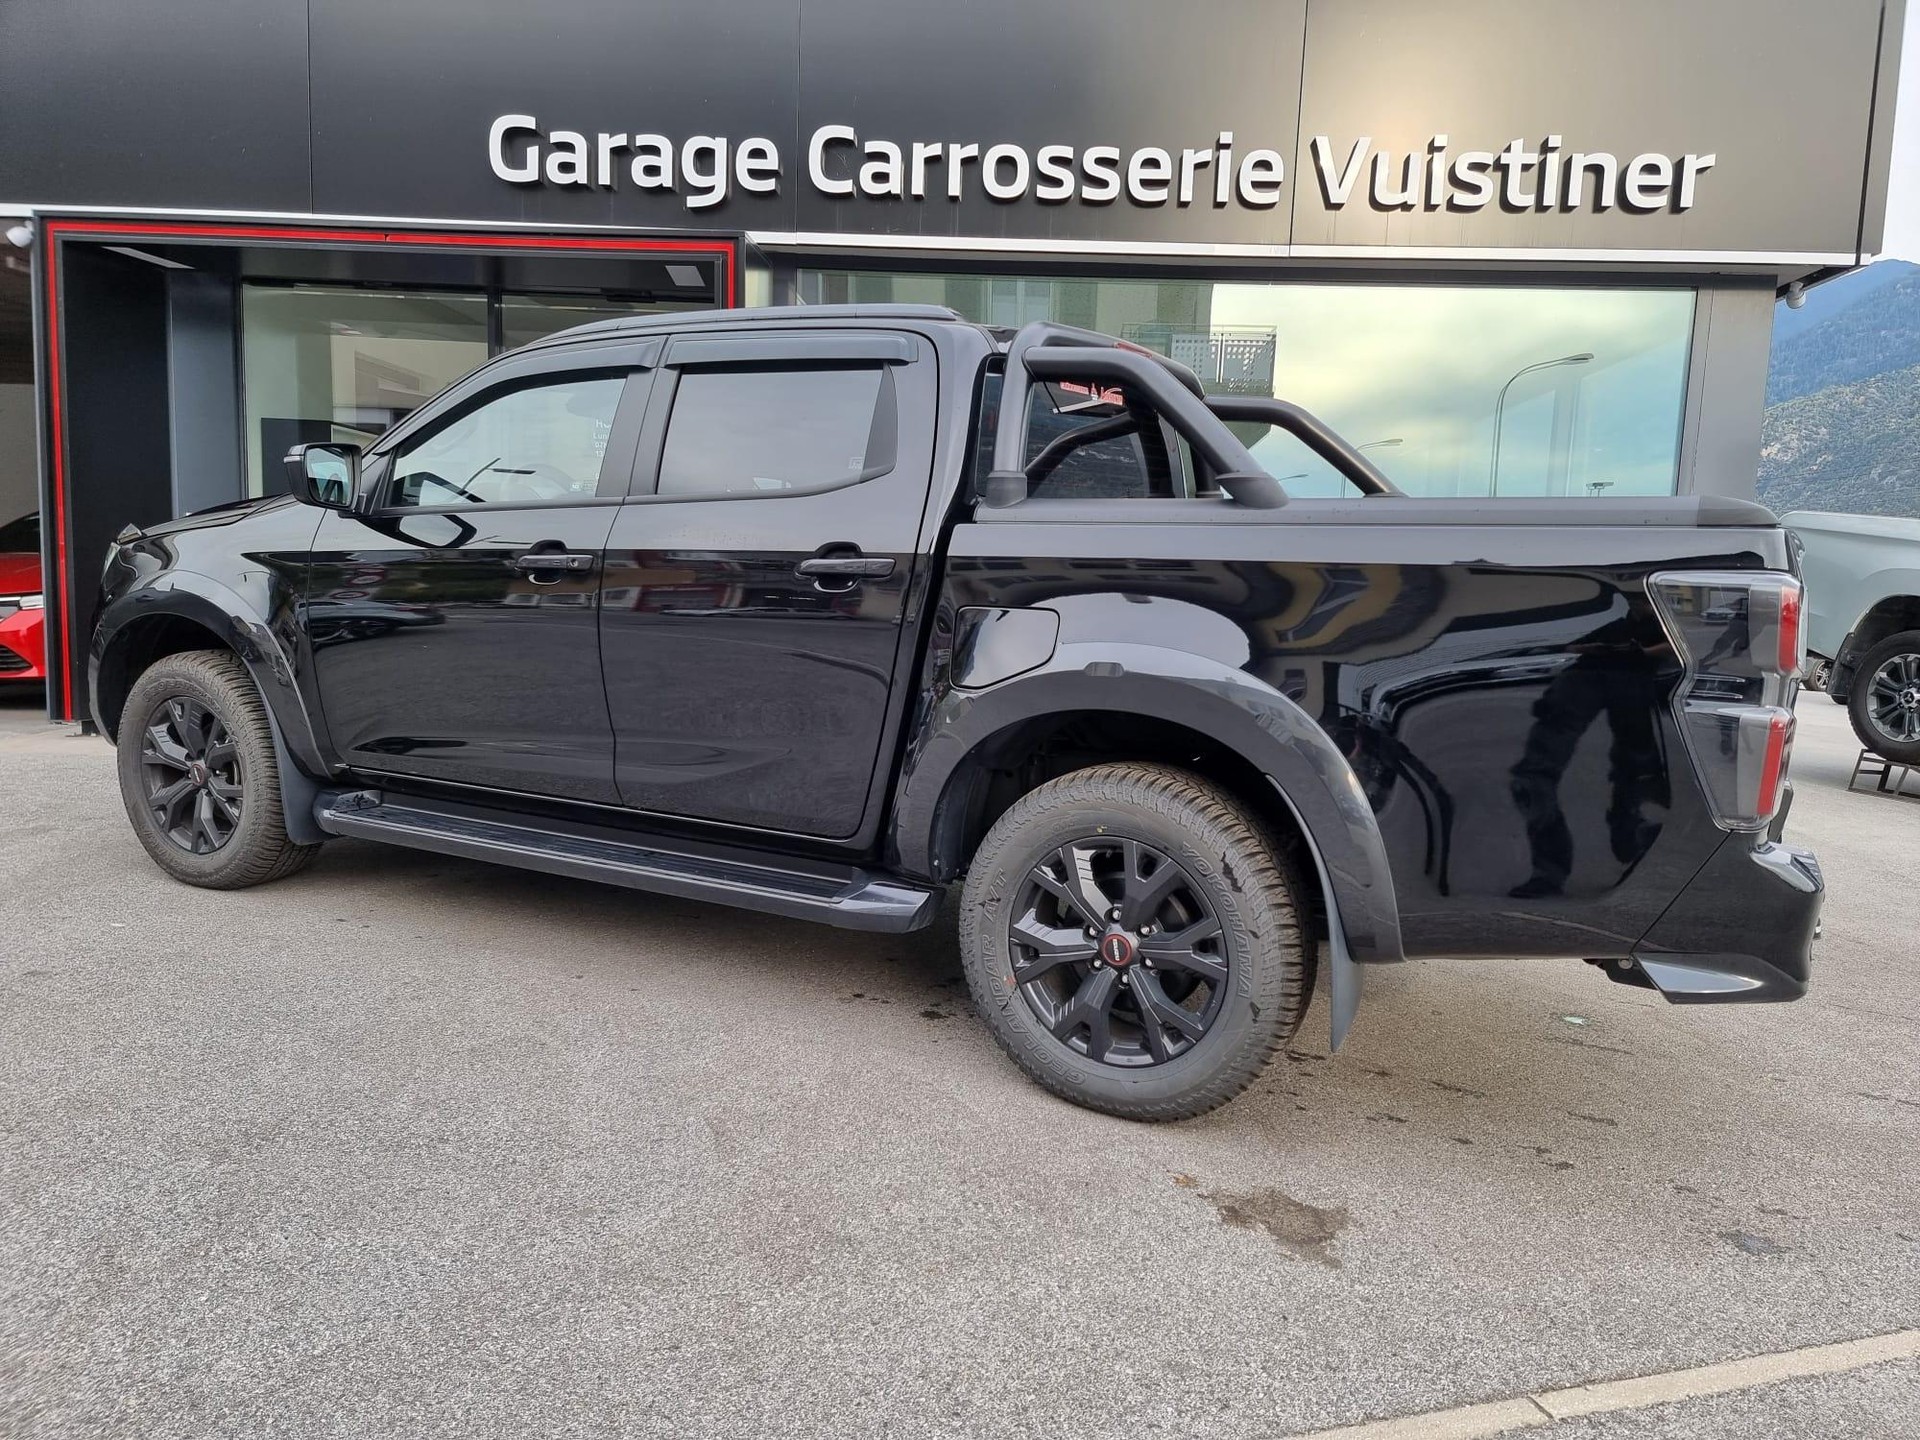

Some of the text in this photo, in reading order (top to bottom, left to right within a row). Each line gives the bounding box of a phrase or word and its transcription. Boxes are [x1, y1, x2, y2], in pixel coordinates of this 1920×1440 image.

[488, 113, 1717, 210] Garage Carrosserie Vuistiner
[981, 868, 1088, 1087] GEOLANDAR A/T
[1181, 840, 1253, 999] YOKOHAMA
